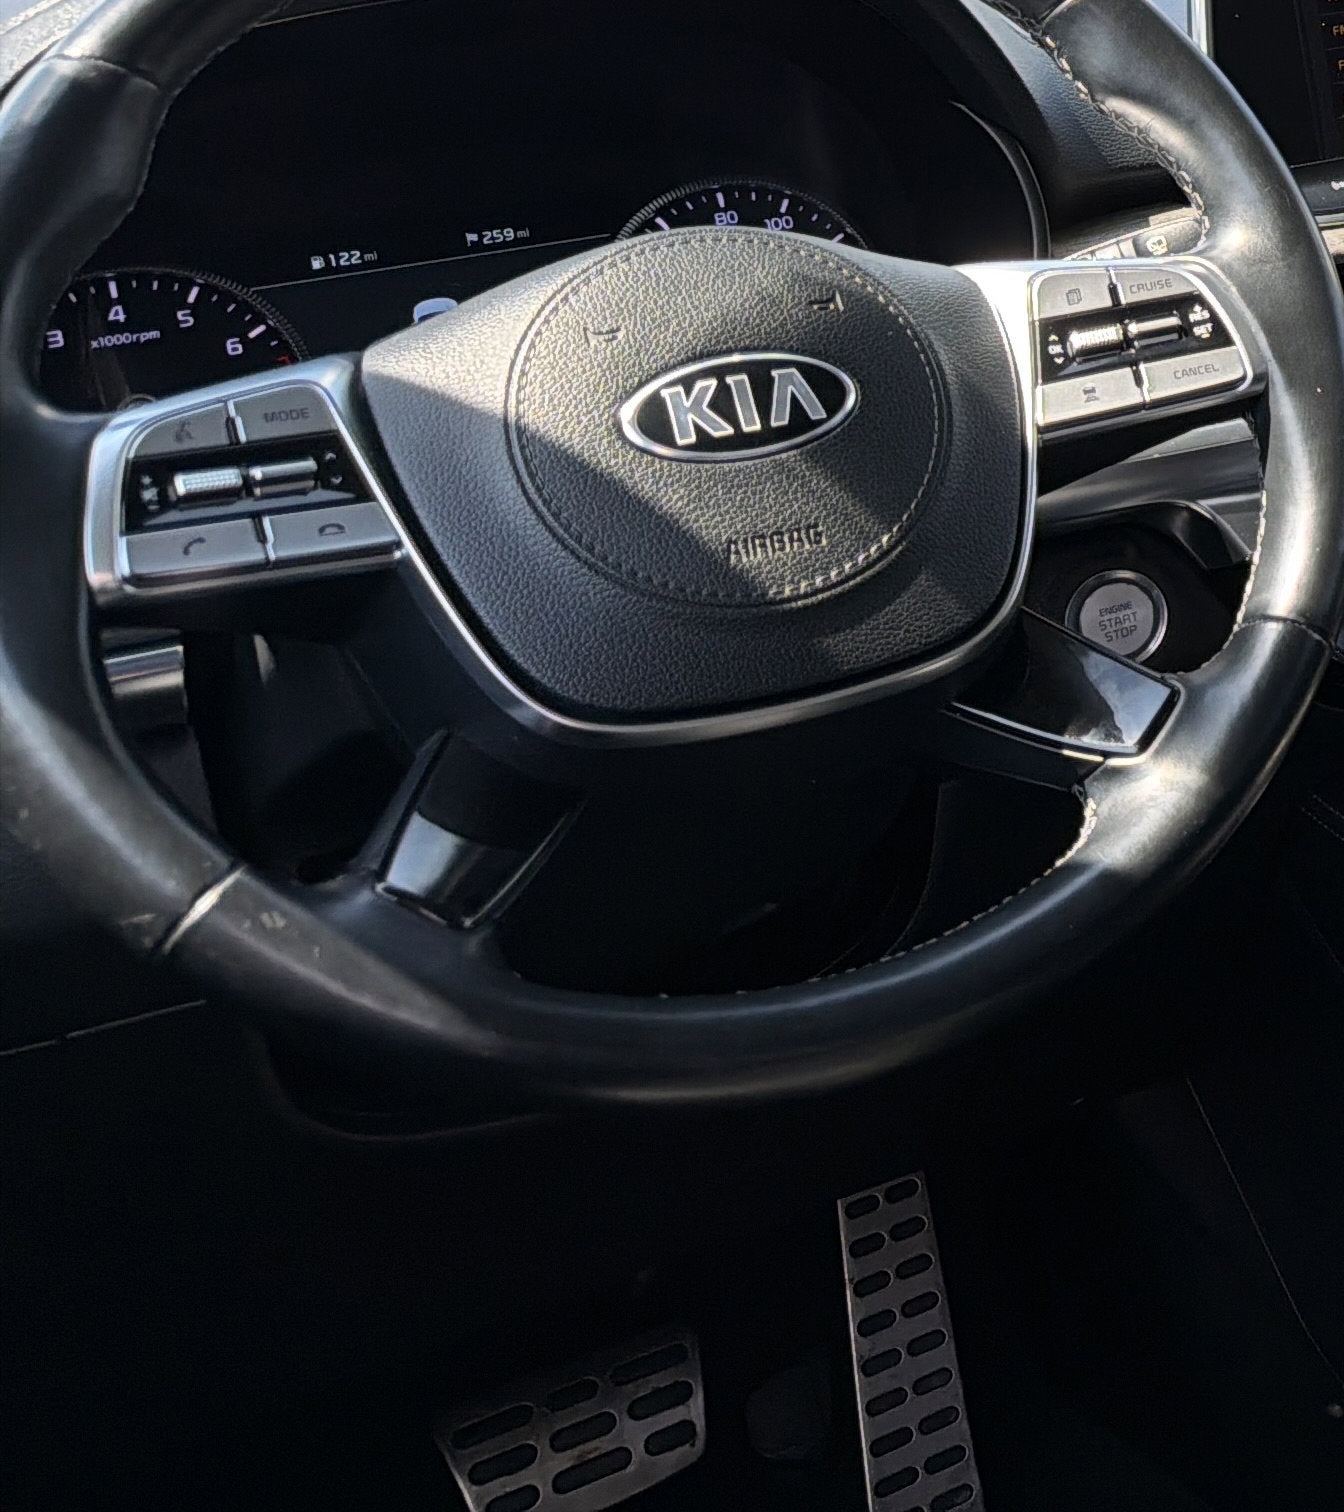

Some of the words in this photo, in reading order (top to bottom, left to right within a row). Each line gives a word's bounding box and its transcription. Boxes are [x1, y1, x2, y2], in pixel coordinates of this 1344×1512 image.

[713, 210, 740, 226] 80
[764, 214, 795, 233] 100
[481, 226, 516, 245] 259
[327, 250, 364, 269] 122
[1128, 277, 1174, 295] CRUISE
[107, 304, 127, 325] 4
[176, 309, 195, 329] 5
[45, 329, 66, 350] 3
[225, 337, 244, 357] 6
[1172, 363, 1220, 381] CANCEL
[263, 406, 311, 424] MODE
[660, 367, 828, 447] KIA
[725, 523, 827, 564] AIRBAG
[1098, 600, 1133, 618] ENGINE
[1098, 611, 1138, 631] START
[1104, 624, 1138, 642] STOP
